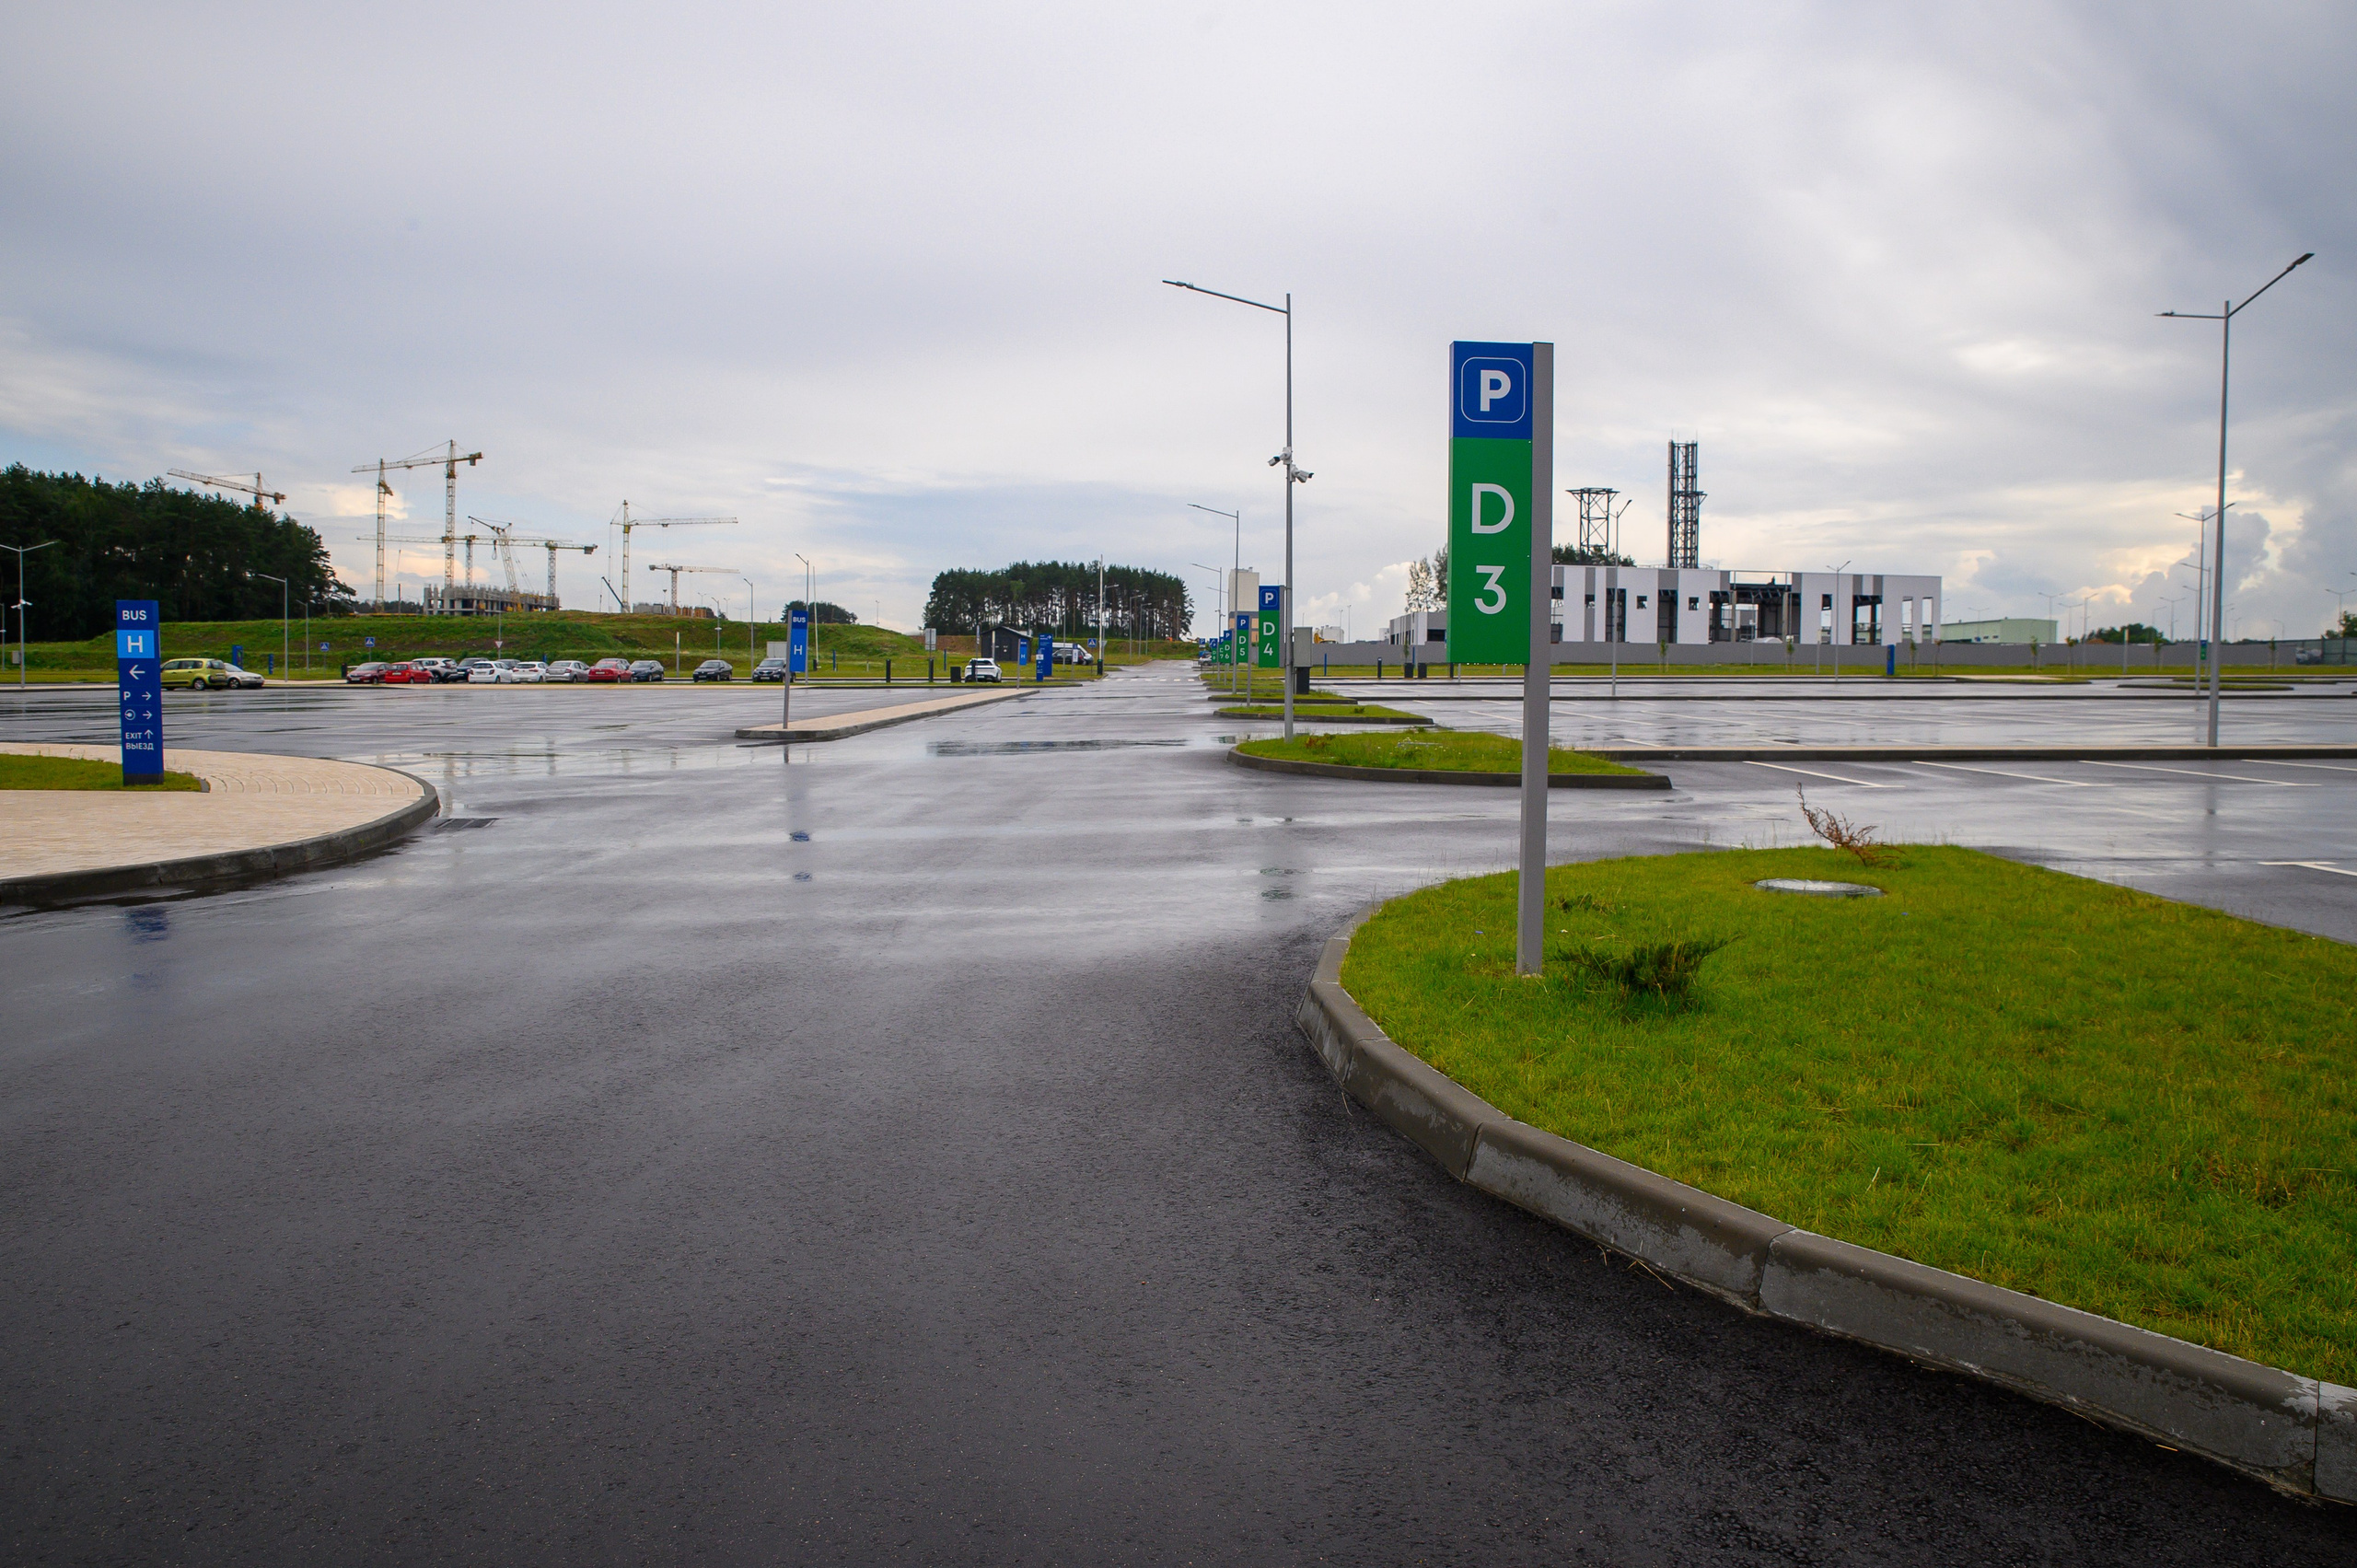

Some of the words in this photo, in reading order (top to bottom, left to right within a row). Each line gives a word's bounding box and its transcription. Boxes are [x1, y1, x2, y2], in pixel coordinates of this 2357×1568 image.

[1480, 369, 1512, 412] P
[1471, 482, 1515, 534] D
[1474, 564, 1507, 615] 3
[1265, 592, 1273, 604] P
[122, 610, 147, 621] BUS
[1263, 621, 1275, 635] D
[127, 635, 144, 653] H
[1238, 635, 1247, 645] D
[794, 645, 803, 655] H
[1239, 647, 1245, 656] 5
[1263, 643, 1273, 656] 4
[123, 691, 132, 701] P
[125, 742, 154, 750] ВЫЕЗД
